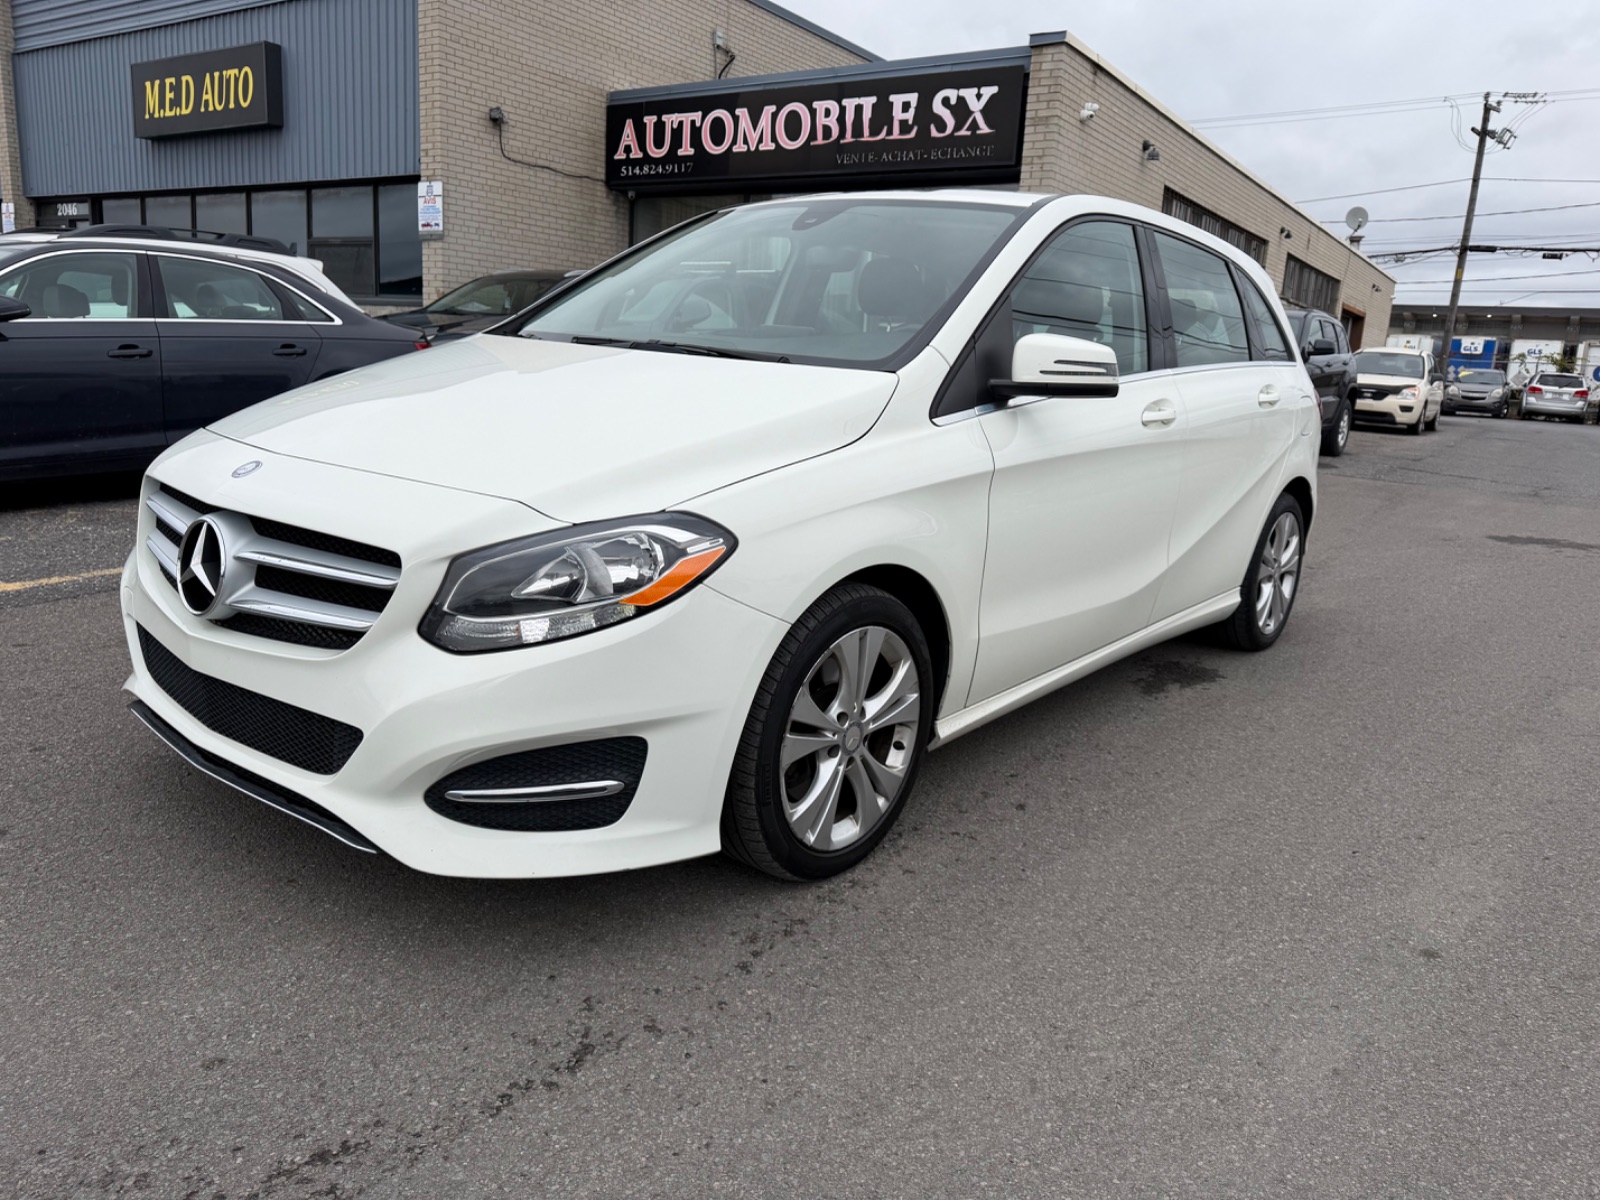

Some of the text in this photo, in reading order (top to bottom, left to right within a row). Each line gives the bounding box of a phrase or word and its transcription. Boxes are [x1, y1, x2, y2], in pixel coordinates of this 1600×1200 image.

[144, 65, 253, 119] M.E.D AUTO
[613, 85, 999, 160] AUTOMOBILE SX
[620, 161, 694, 177] 514.824.9117
[56, 202, 78, 216] 2046
[1463, 345, 1479, 353] GLS
[1527, 348, 1543, 356] GLS
